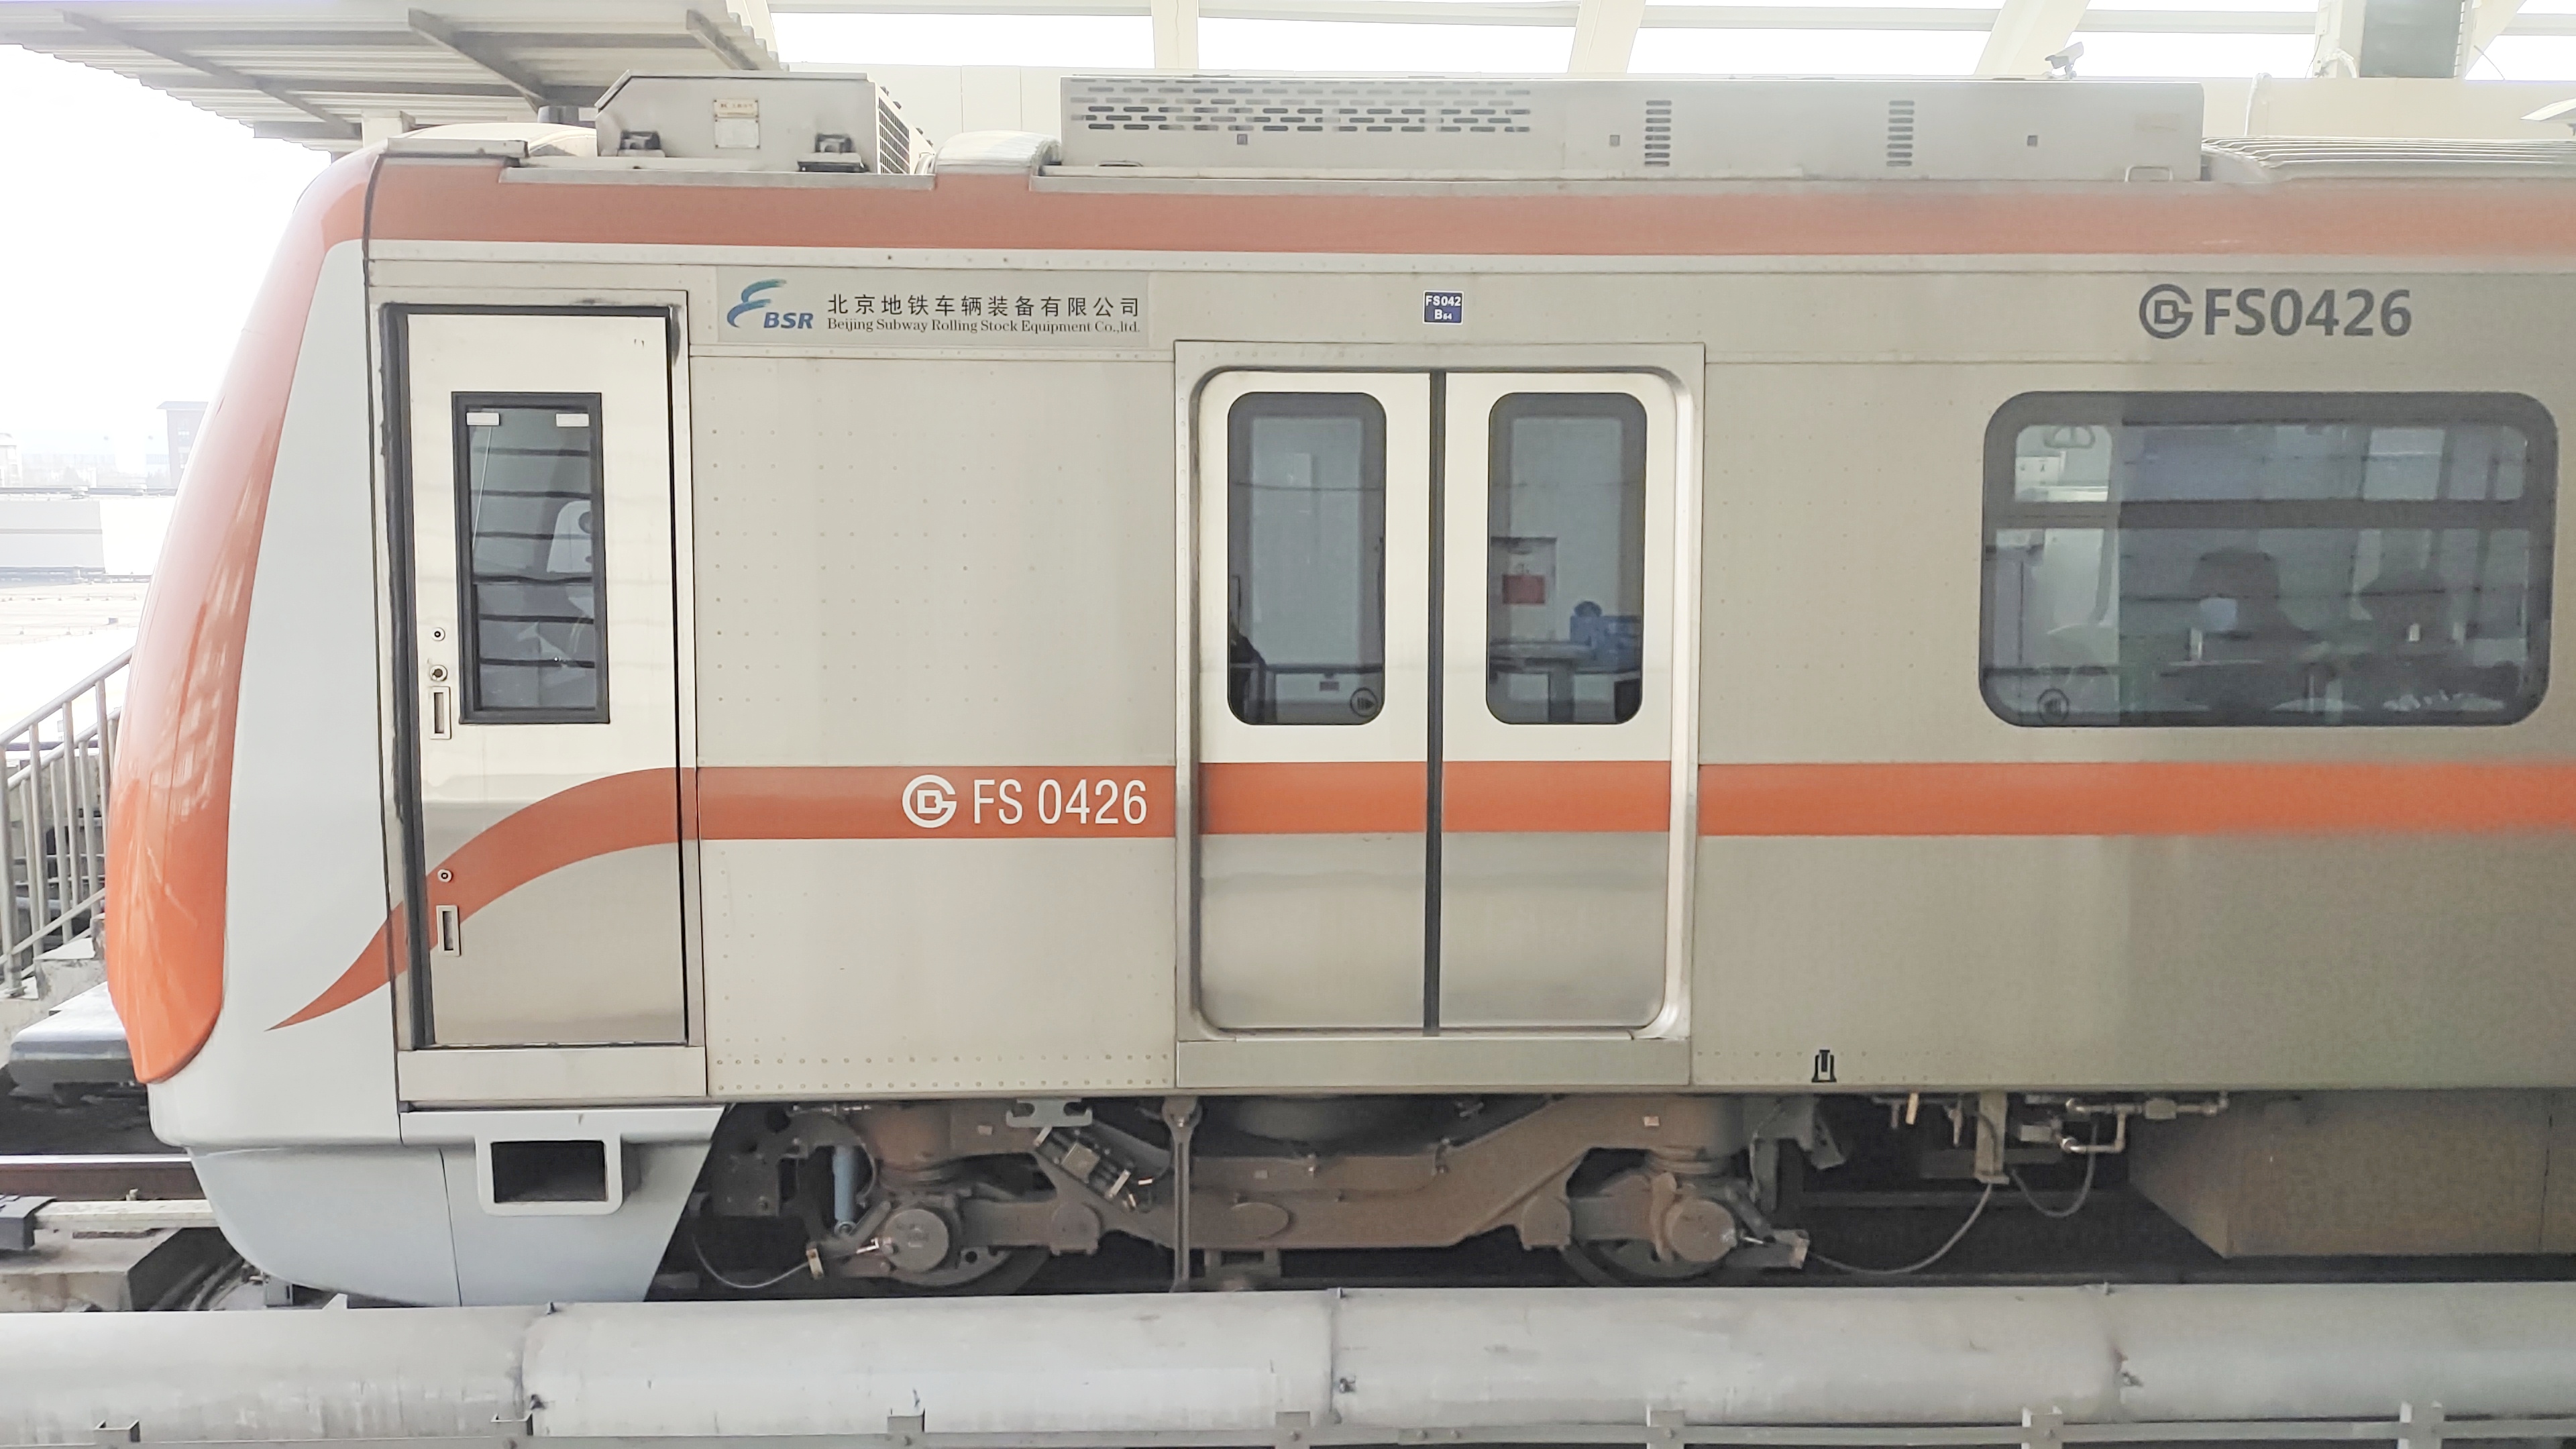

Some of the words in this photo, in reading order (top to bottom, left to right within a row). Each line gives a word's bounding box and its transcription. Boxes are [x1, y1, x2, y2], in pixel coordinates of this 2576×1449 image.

[827, 294, 1138, 317] 北京地铁车辆装备有限公司
[1426, 295, 1461, 307] FS042
[763, 312, 814, 329] BSR
[2204, 288, 2412, 337] FS0426
[827, 318, 873, 332] Beijing
[876, 319, 928, 333] Subway
[932, 319, 978, 333] Rolling
[981, 320, 1018, 332] Stock
[1022, 321, 1090, 335] Equipment
[973, 779, 1023, 824] FS
[1038, 779, 1147, 824] 0426
